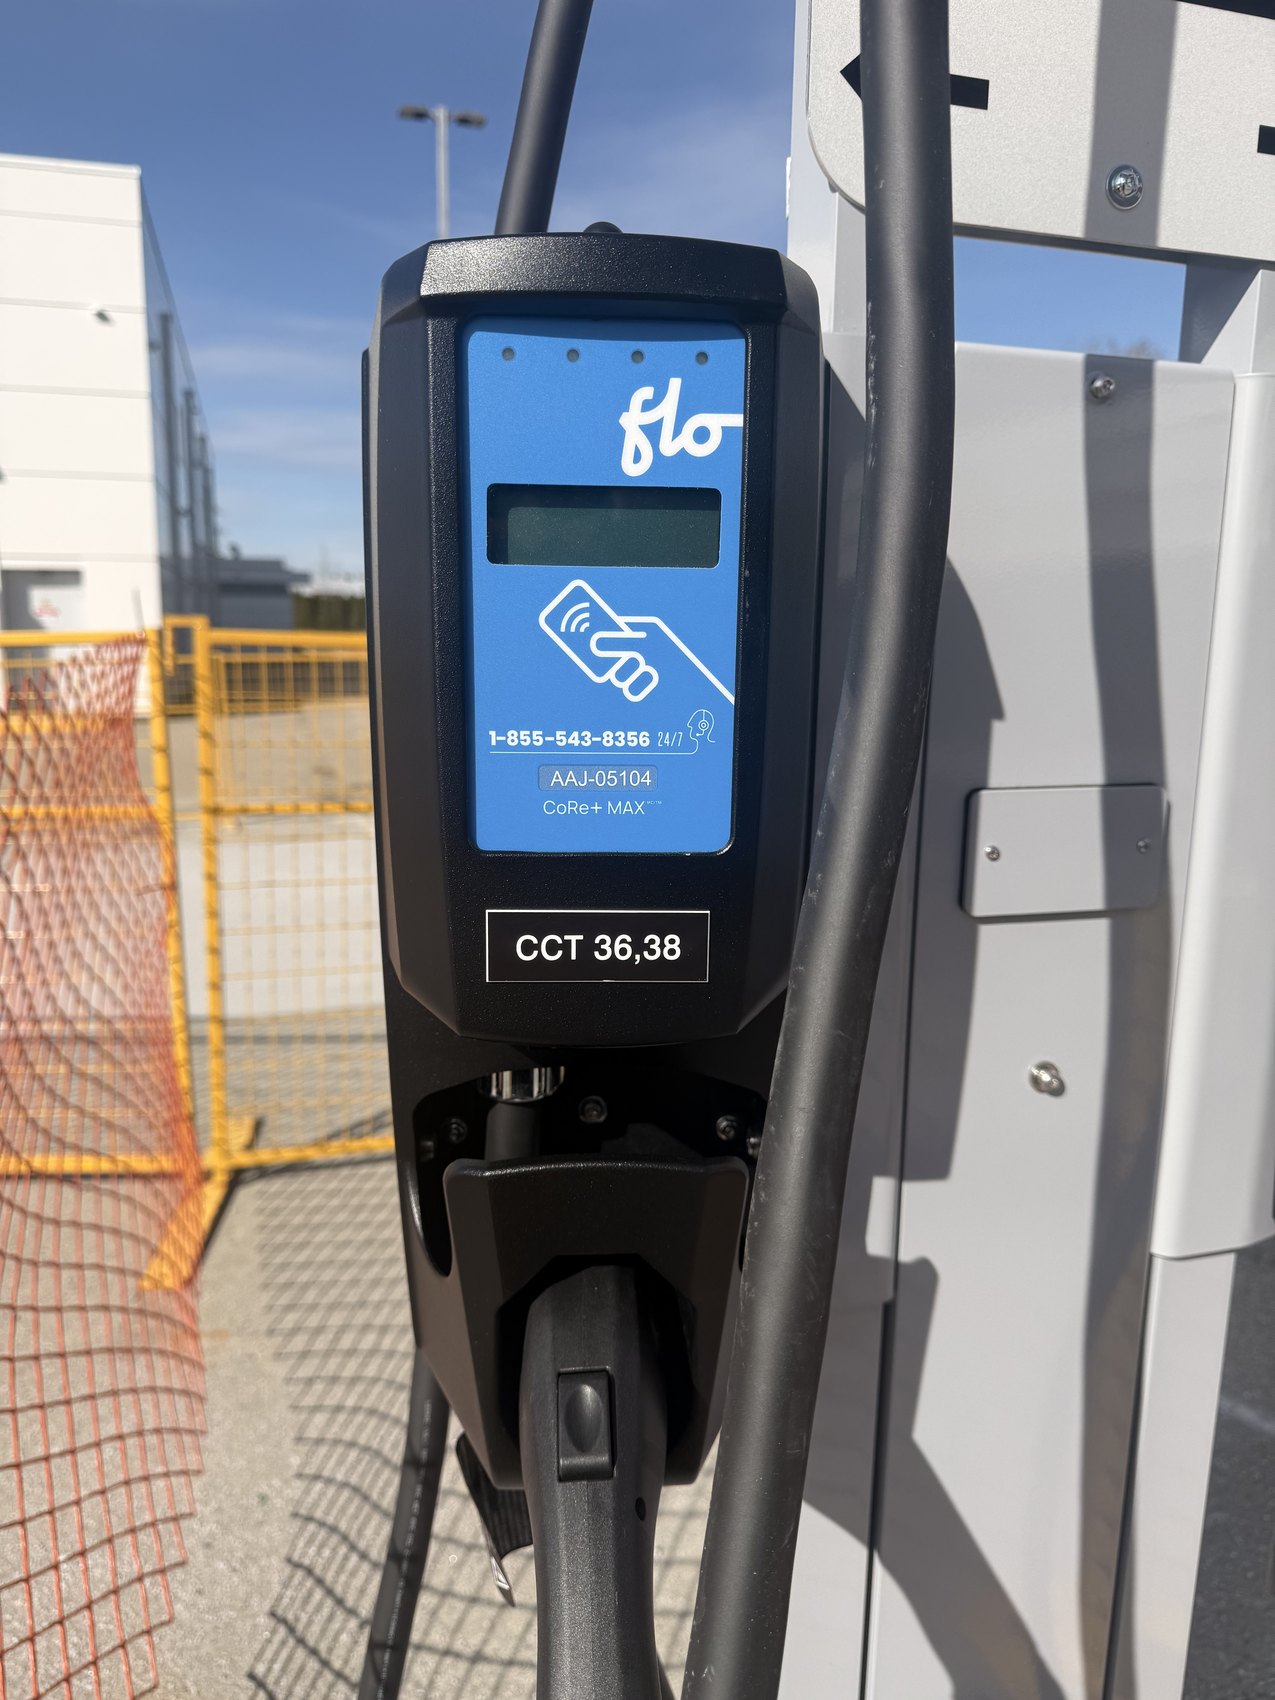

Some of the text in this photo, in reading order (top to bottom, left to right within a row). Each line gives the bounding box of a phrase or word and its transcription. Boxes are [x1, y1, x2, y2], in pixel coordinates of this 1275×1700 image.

[619, 377, 744, 477] flo
[489, 730, 683, 747] 1-855-543-8356 24/7
[550, 770, 652, 787] AAJ-05104
[543, 800, 602, 815] CoRe+
[516, 934, 682, 965] CCT 36,38
